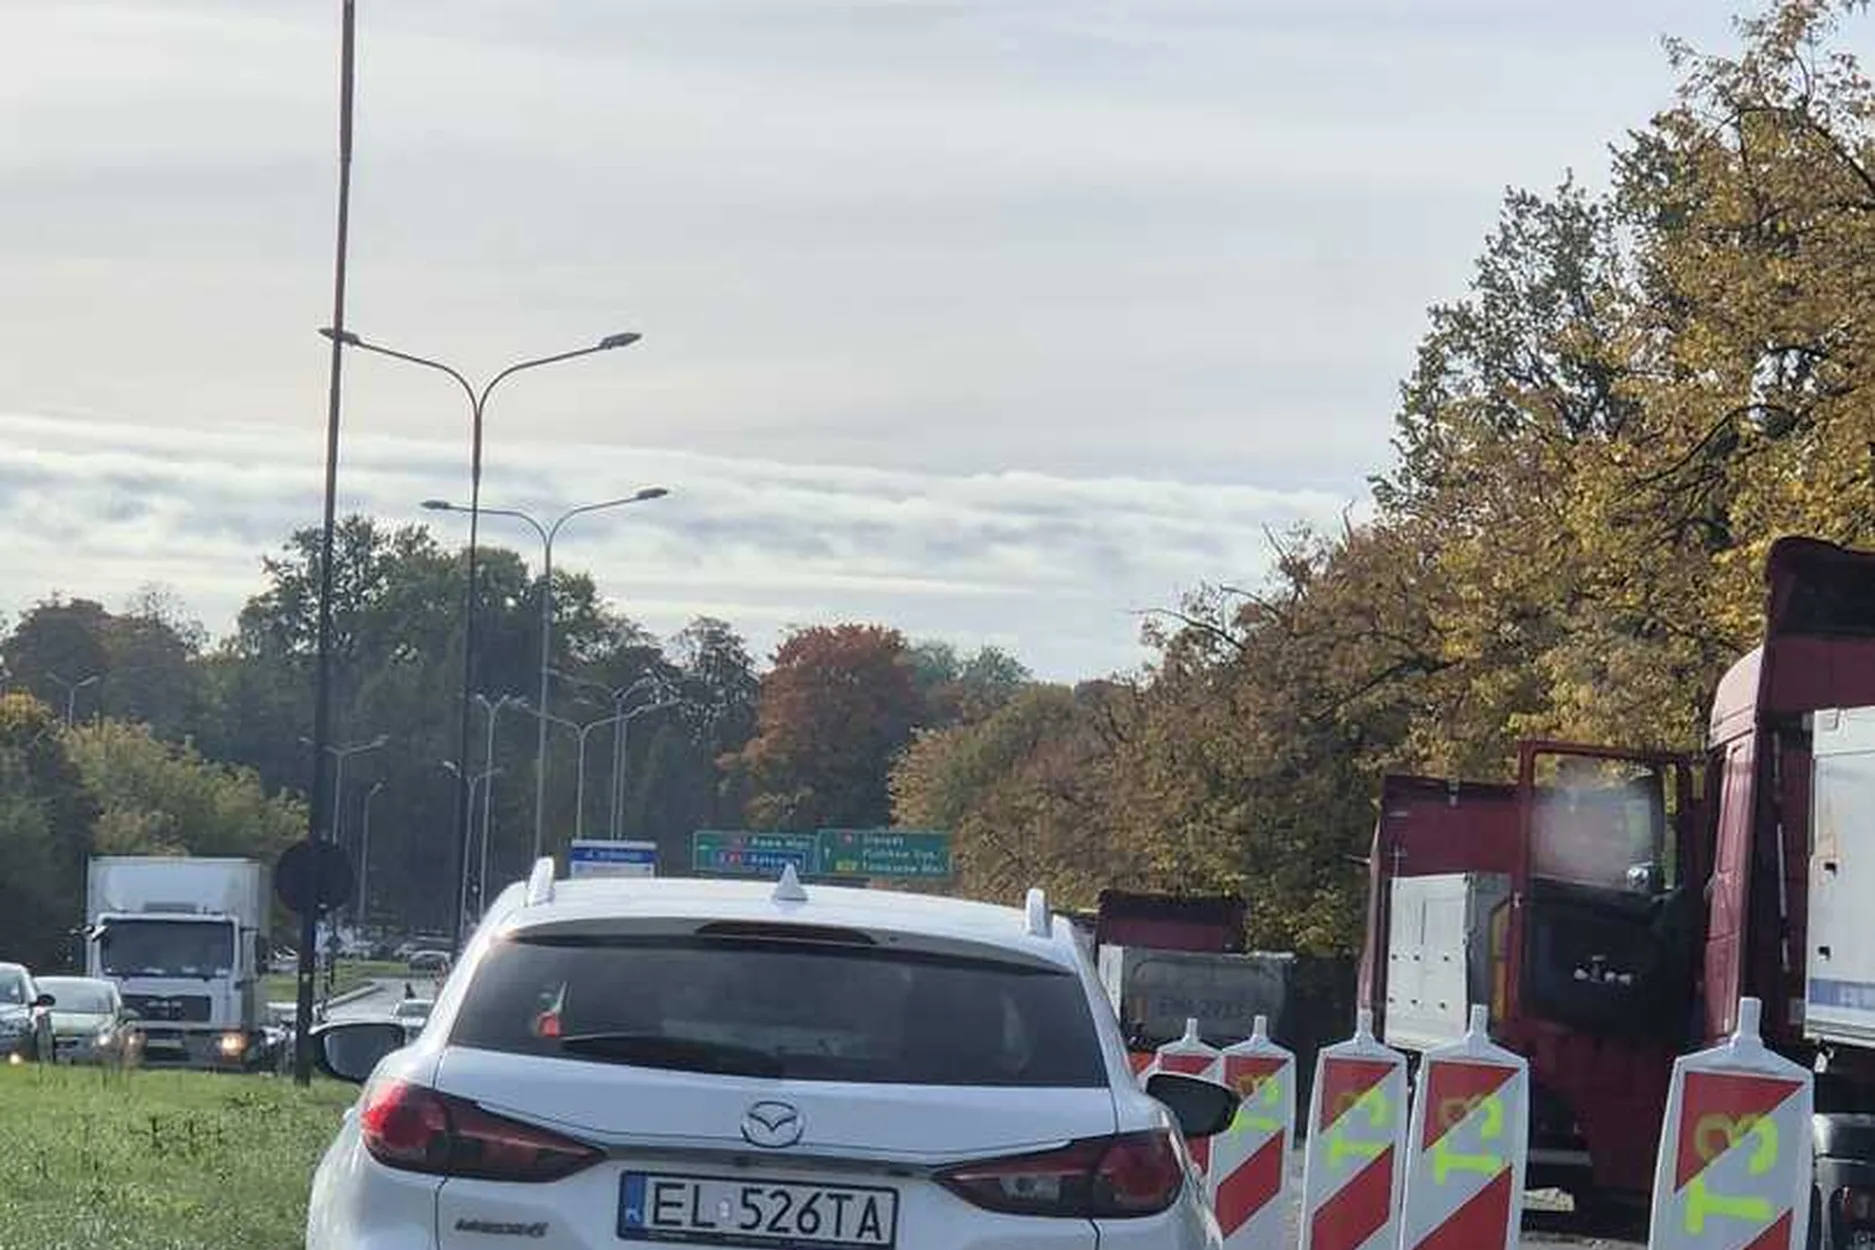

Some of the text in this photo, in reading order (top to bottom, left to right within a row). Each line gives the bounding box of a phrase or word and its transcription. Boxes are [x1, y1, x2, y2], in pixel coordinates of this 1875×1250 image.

[1433, 1092, 1503, 1187] T3
[1683, 1112, 1778, 1235] T3
[652, 1182, 883, 1241] EL 526TA
